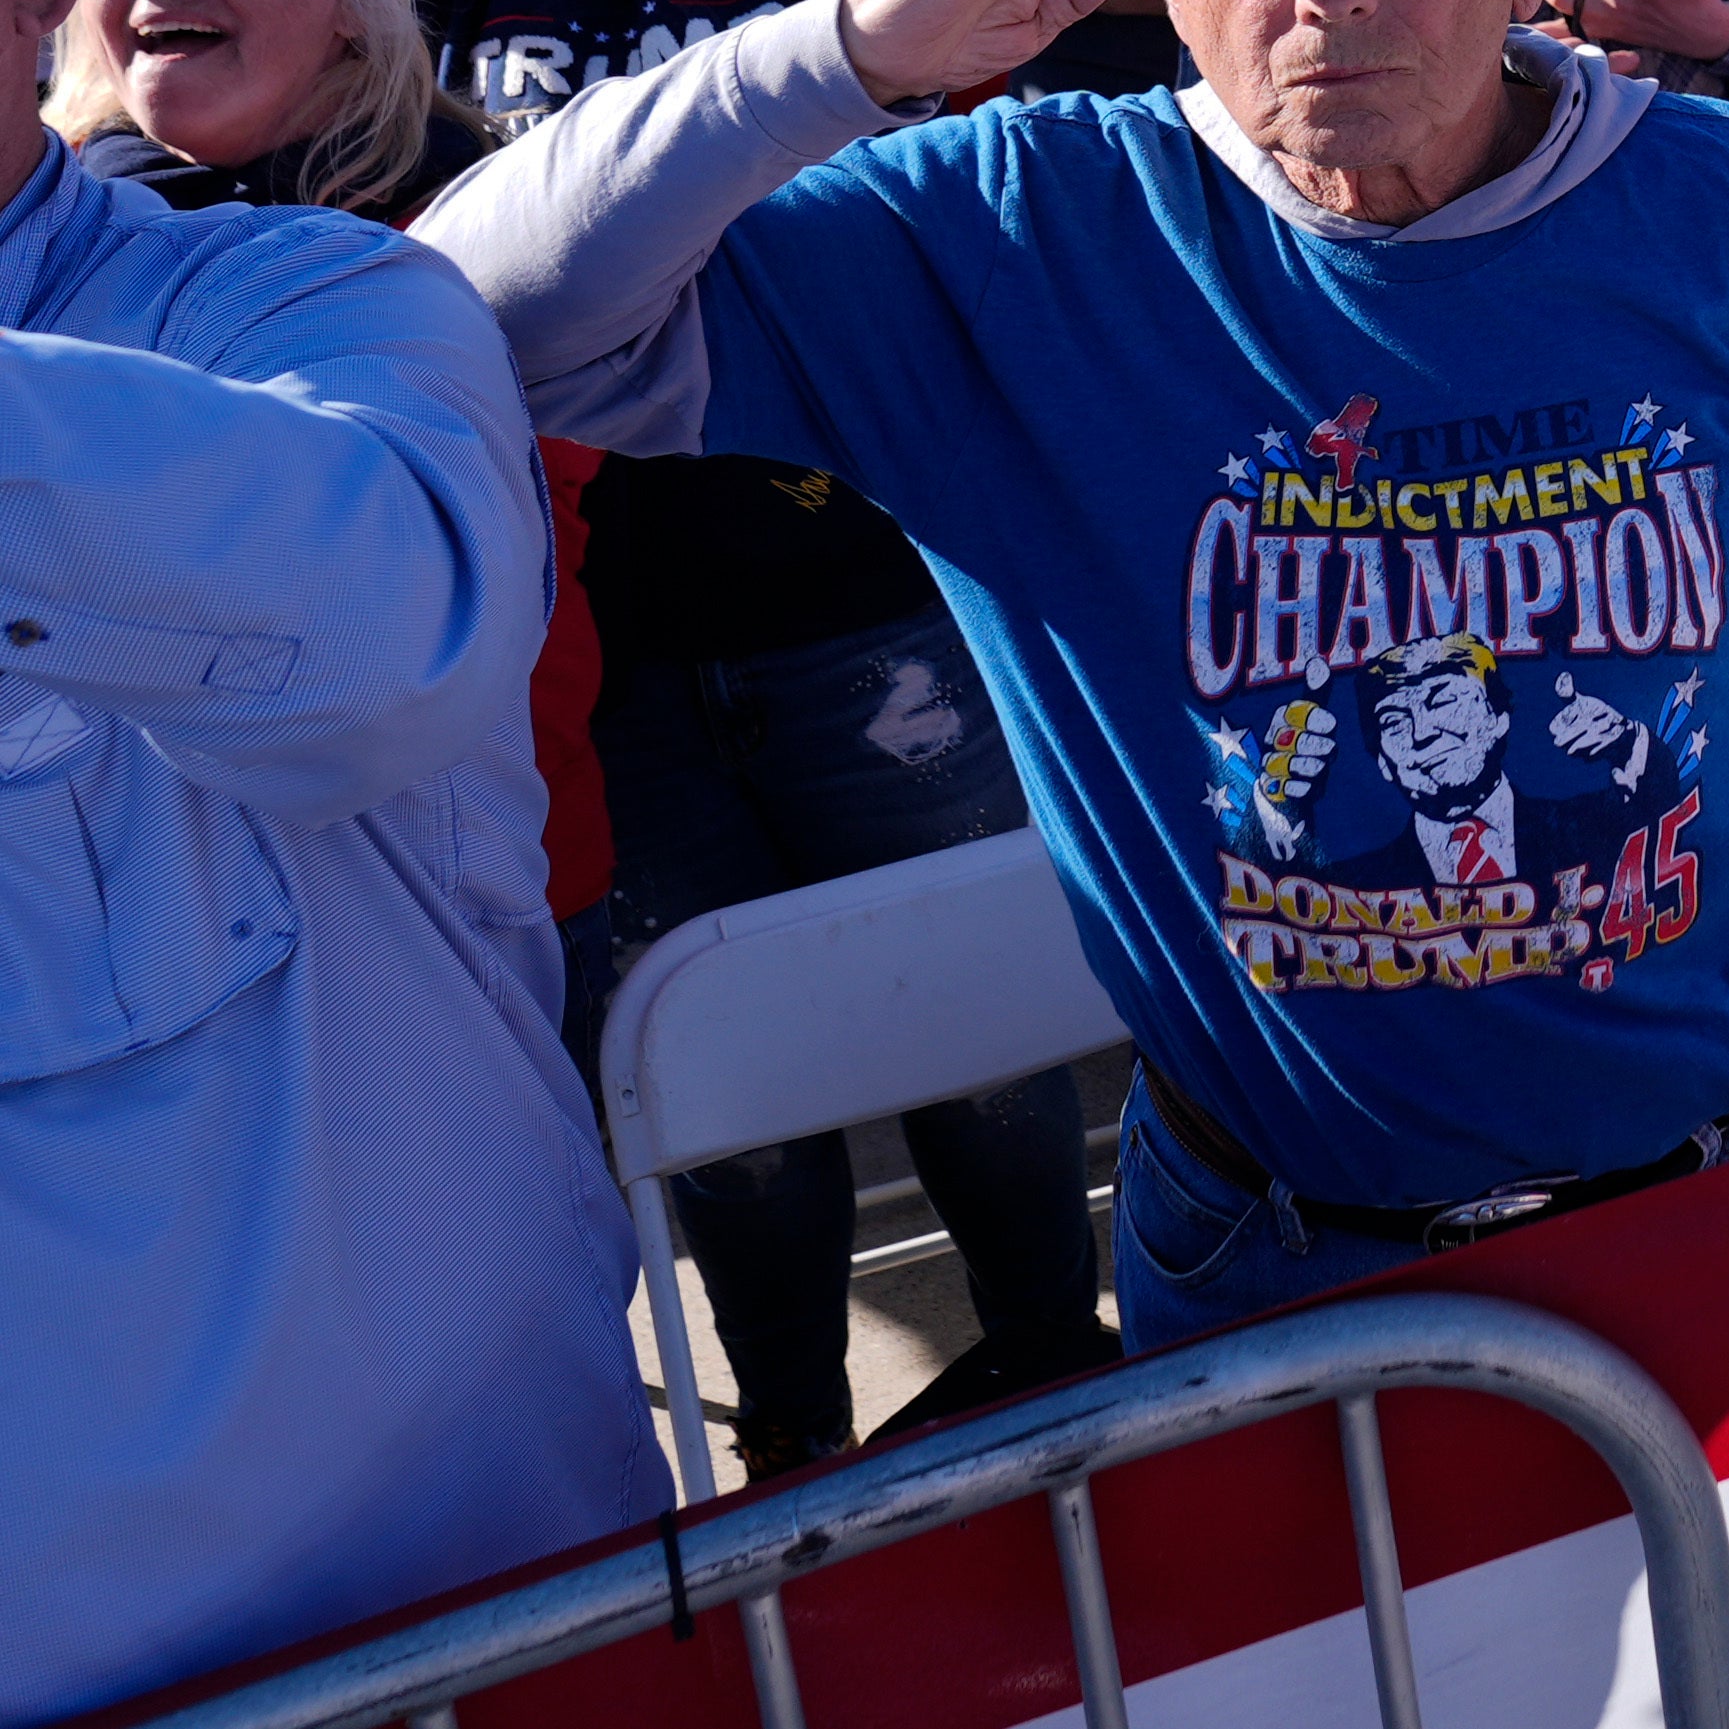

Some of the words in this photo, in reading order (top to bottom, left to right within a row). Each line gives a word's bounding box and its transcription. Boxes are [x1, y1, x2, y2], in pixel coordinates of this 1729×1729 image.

[1384, 400, 1594, 474] TIME
[1261, 446, 1649, 531] INDICTMENT
[1186, 464, 1723, 699] CHAMPION
[1217, 849, 1536, 934] DONALD
[1600, 785, 1702, 963] 45
[1221, 918, 1594, 992] TRUMP
